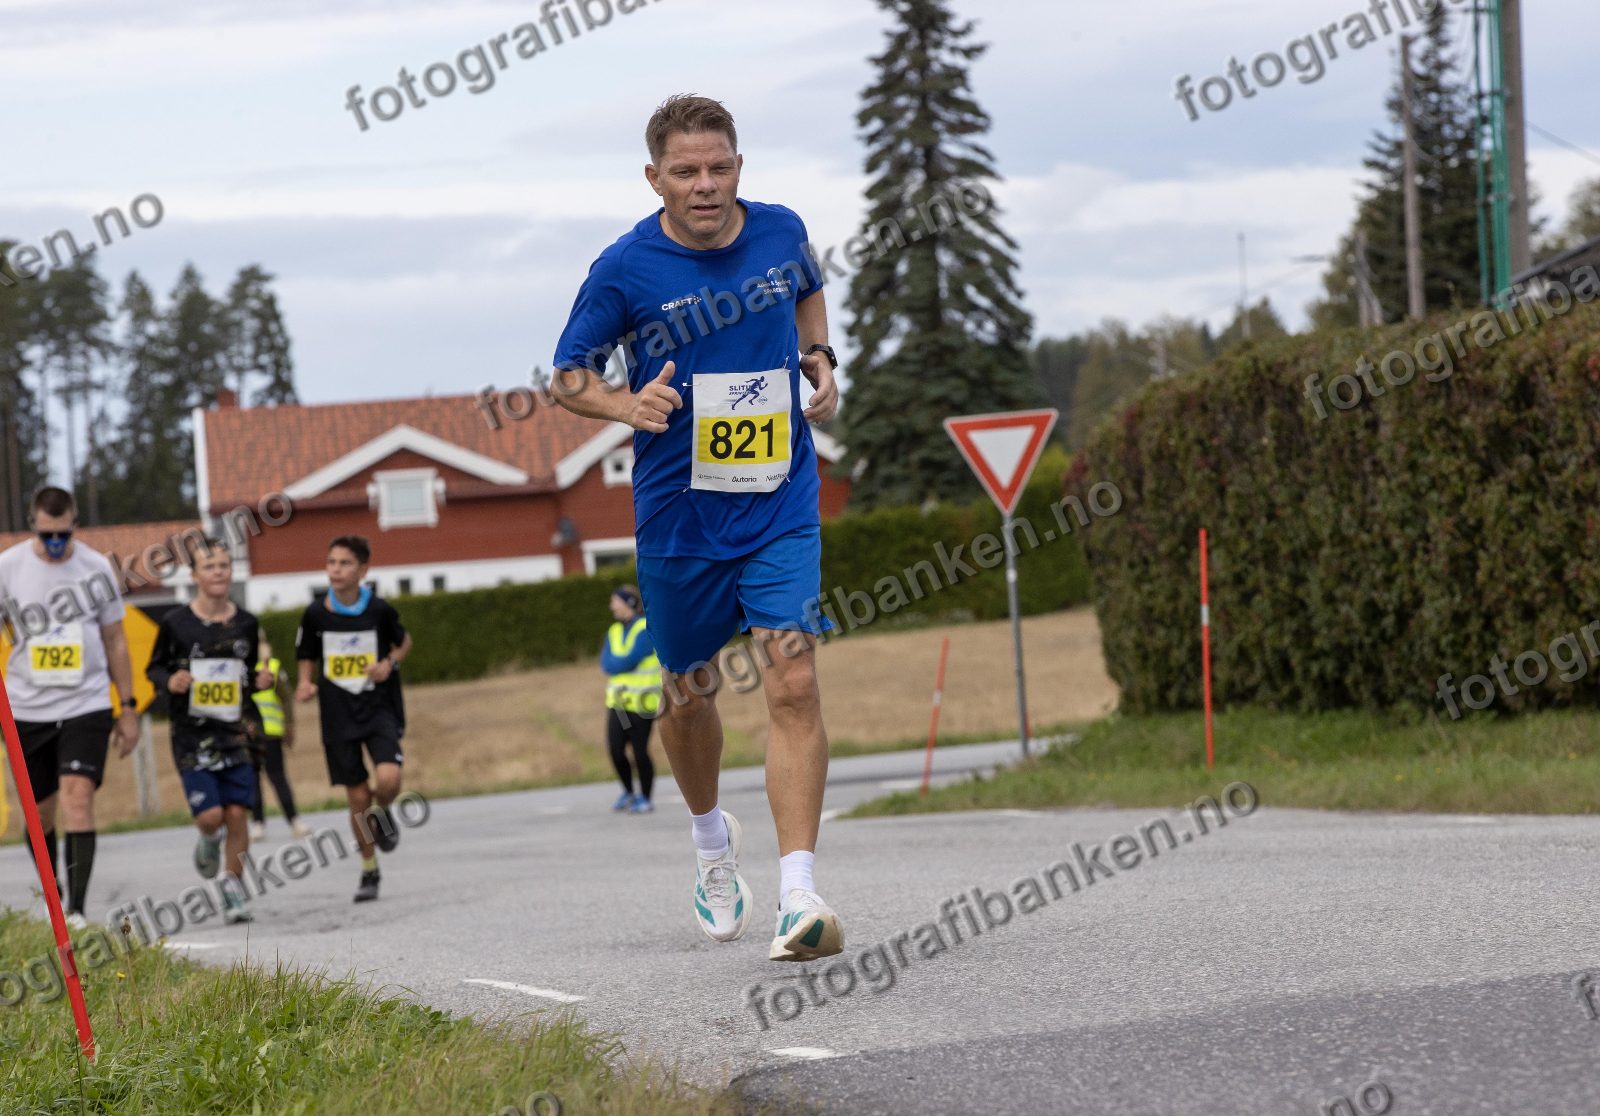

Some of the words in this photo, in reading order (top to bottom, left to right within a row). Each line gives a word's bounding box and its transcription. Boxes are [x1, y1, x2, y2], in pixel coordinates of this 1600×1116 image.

[661, 297, 693, 312] CRAFT
[709, 418, 774, 460] 821
[36, 646, 74, 668] 792
[332, 655, 368, 676] 879
[198, 683, 234, 704] 903
